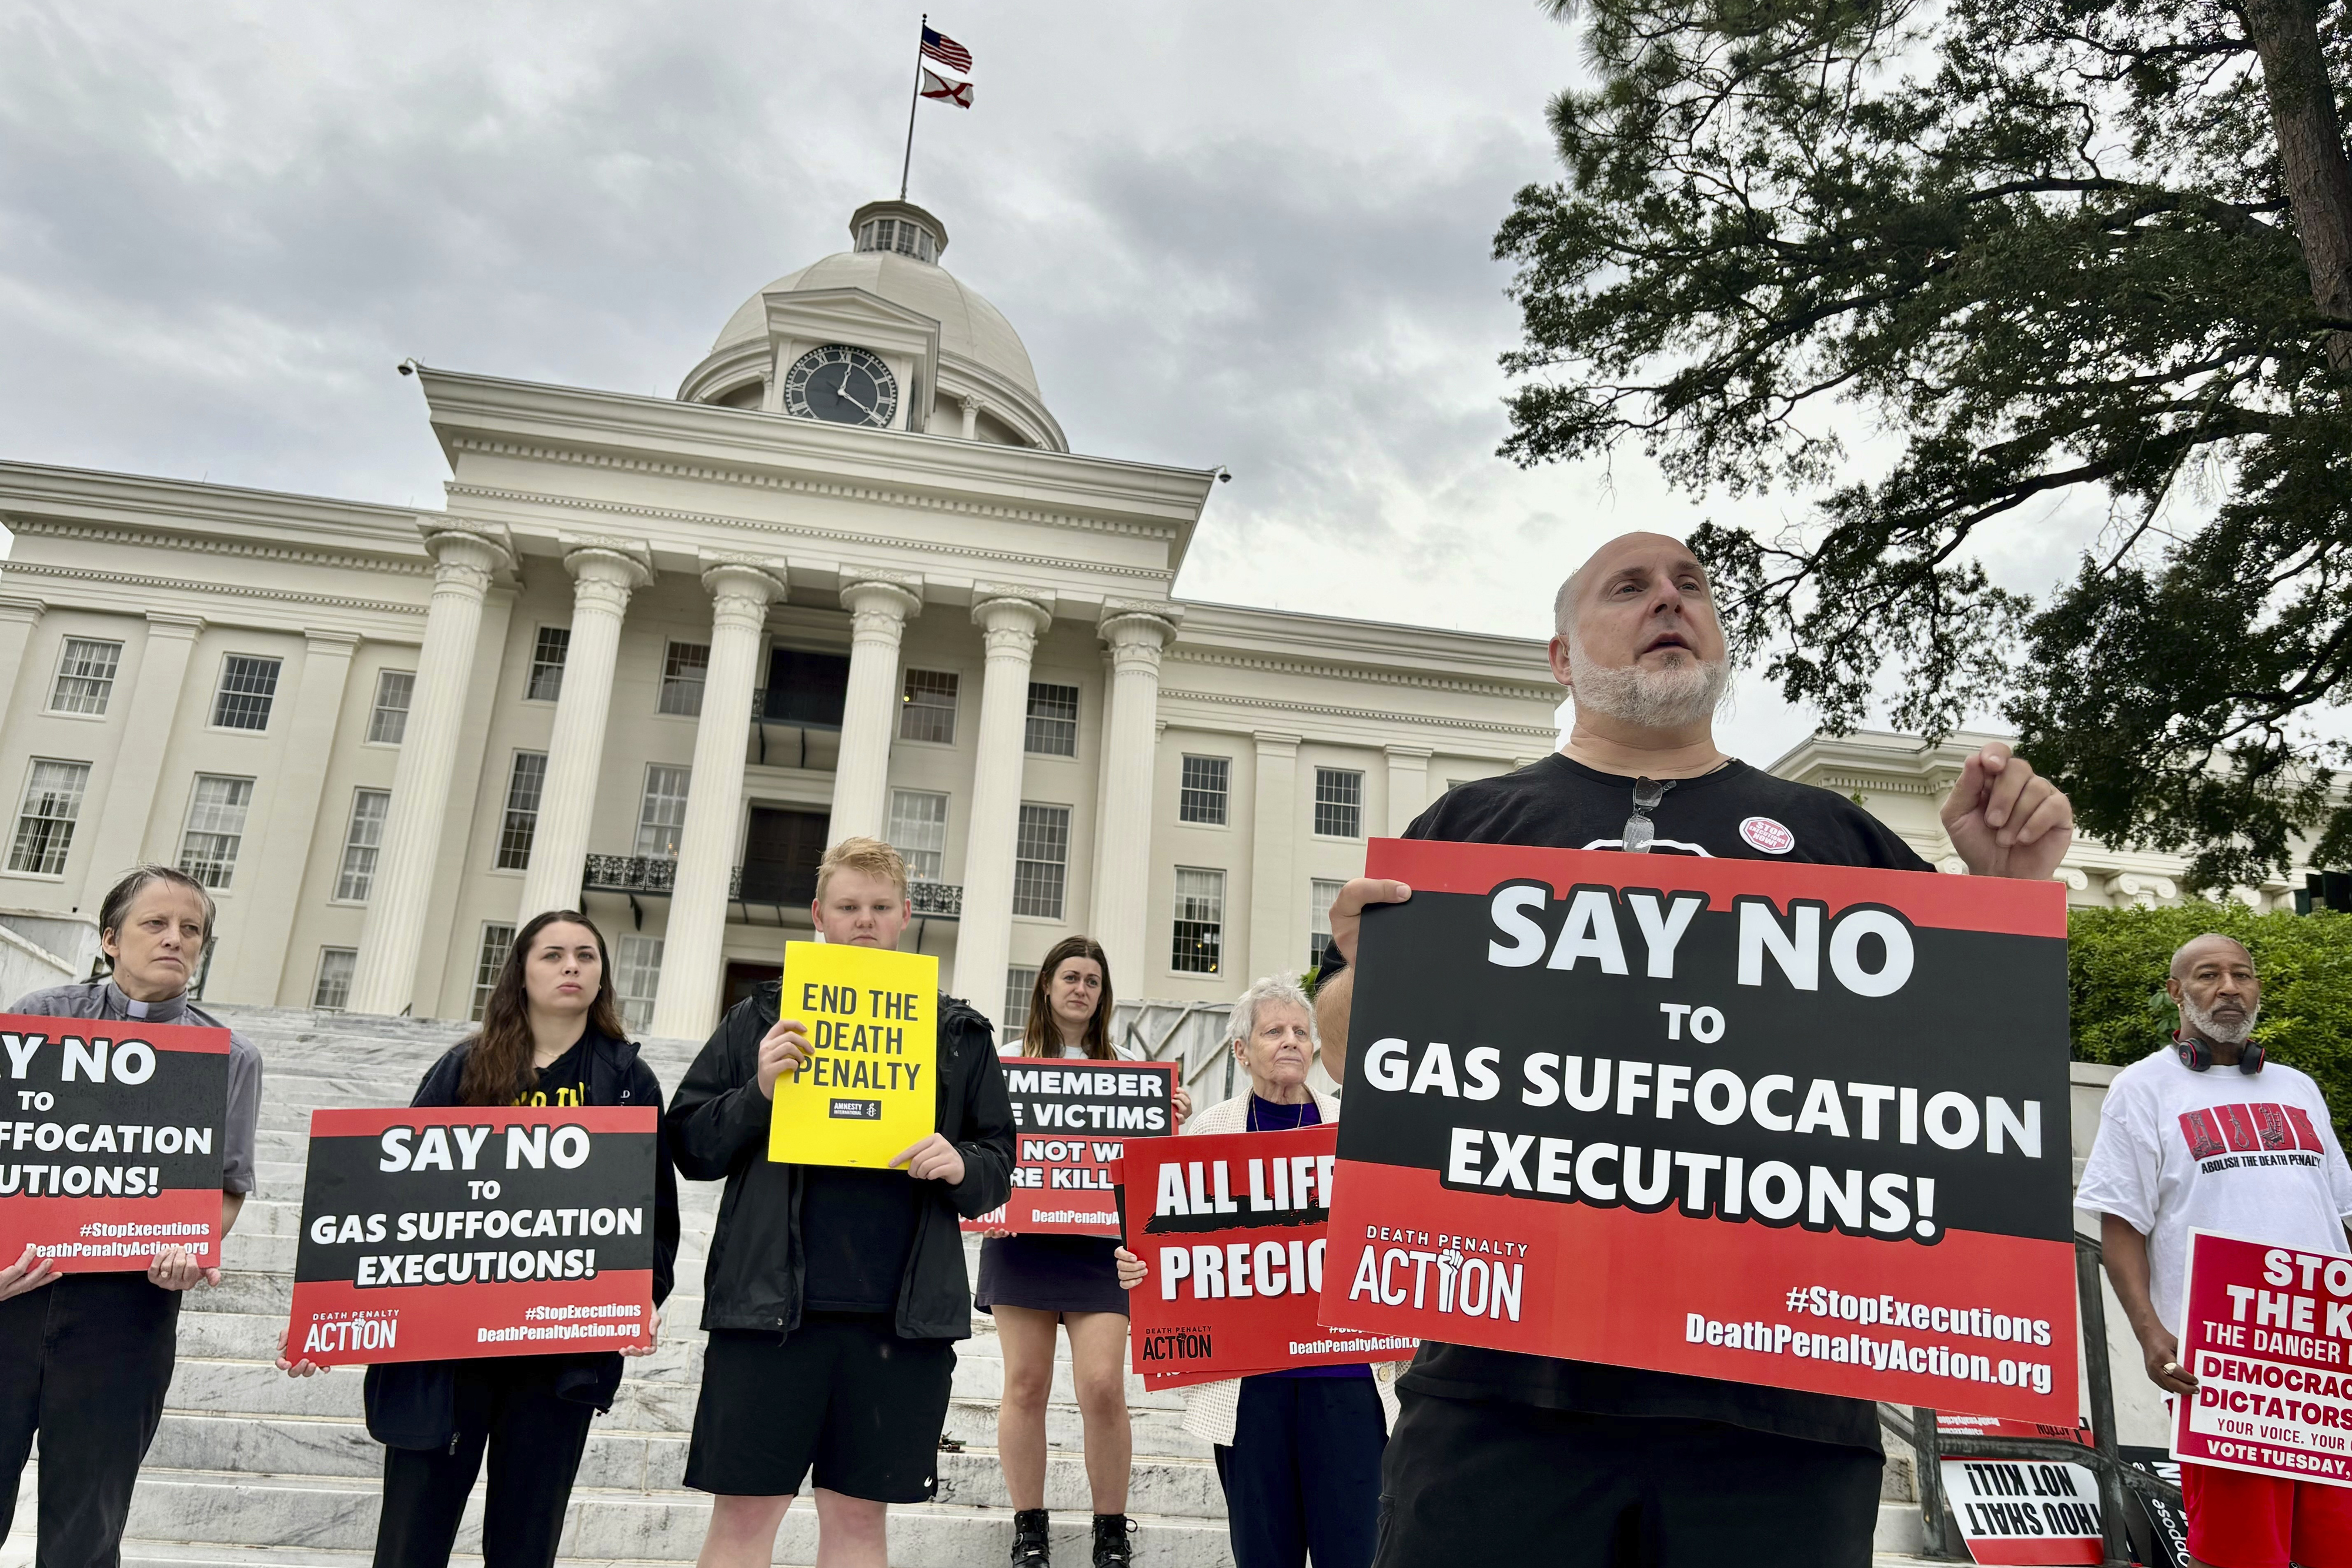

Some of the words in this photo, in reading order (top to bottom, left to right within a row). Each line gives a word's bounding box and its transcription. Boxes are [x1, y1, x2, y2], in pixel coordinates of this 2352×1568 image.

[1748, 825, 1786, 845] EXECUTIONS
[1756, 821, 1785, 836] STOP
[1488, 886, 1702, 978] SAY
[1738, 902, 1914, 997] NO
[803, 983, 857, 1015] END
[869, 989, 918, 1021] THE
[815, 1020, 902, 1054] DEATH
[1661, 1003, 1725, 1043] TO
[62, 1039, 155, 1085] NO
[794, 1056, 921, 1091] PENALTY
[1002, 1070, 1163, 1097] MEMBER
[1364, 1038, 1500, 1100] GAS
[1522, 1053, 2041, 1158] SUFFOCATION
[18, 1091, 54, 1111] TO
[1033, 1104, 1165, 1129] VICTIMS
[380, 1128, 490, 1172] SAY
[506, 1126, 590, 1169] NO
[1024, 1141, 1085, 1161] NOT
[2201, 1156, 2240, 1174] ABOLISH
[2241, 1155, 2259, 1167] THE
[2260, 1154, 2288, 1166] DEATH
[2288, 1154, 2321, 1169] PENALTY
[0, 1165, 159, 1194] UTIONS!
[468, 1181, 500, 1199] TO
[1053, 1169, 1113, 1189] KILL
[1156, 1161, 1237, 1216] ALL
[1448, 1127, 1935, 1236] EXECUTIONS!
[80, 1222, 209, 1238] #StopExecutions
[311, 1214, 386, 1244] GAS
[397, 1208, 642, 1241] SUFFOCATION
[1032, 1209, 1120, 1225] DeathPenaltyA
[1367, 1226, 1428, 1245] DEATH
[1438, 1235, 1528, 1258] PENALTY
[358, 1249, 595, 1285] EXECUTIONS!
[1349, 1245, 1524, 1322] ACTION
[2263, 1249, 2352, 1297] STO
[352, 1310, 399, 1318] PENALTY
[526, 1303, 641, 1320] #StopExecutions
[1786, 1286, 2050, 1347] #StopExecutions
[2227, 1285, 2315, 1333] THE
[303, 1318, 397, 1352] ACTION
[477, 1323, 640, 1342] DeathPenaltyAction.org
[1175, 1325, 1212, 1333] PENALTY
[1289, 1336, 1422, 1354] DeathPenaltyAction.o
[2203, 1321, 2246, 1348] THE
[2254, 1329, 2340, 1364] DANGER
[1142, 1333, 1212, 1360] ACTION
[1686, 1313, 2050, 1393] DeathPenaltyAction.org
[2203, 1356, 2352, 1400] DEMOCRAC
[2201, 1386, 2352, 1430] DICTATORS
[2217, 1418, 2253, 1435] YOUR
[2260, 1425, 2303, 1444] VOICE.
[2311, 1433, 2344, 1450] YOUR
[2207, 1439, 2257, 1461] VOTE
[2261, 1449, 2350, 1479] TUESDAY,
[1963, 1463, 2029, 1496] KILL!
[2027, 1465, 2078, 1497] NOT
[1964, 1502, 2043, 1535] SHALT
